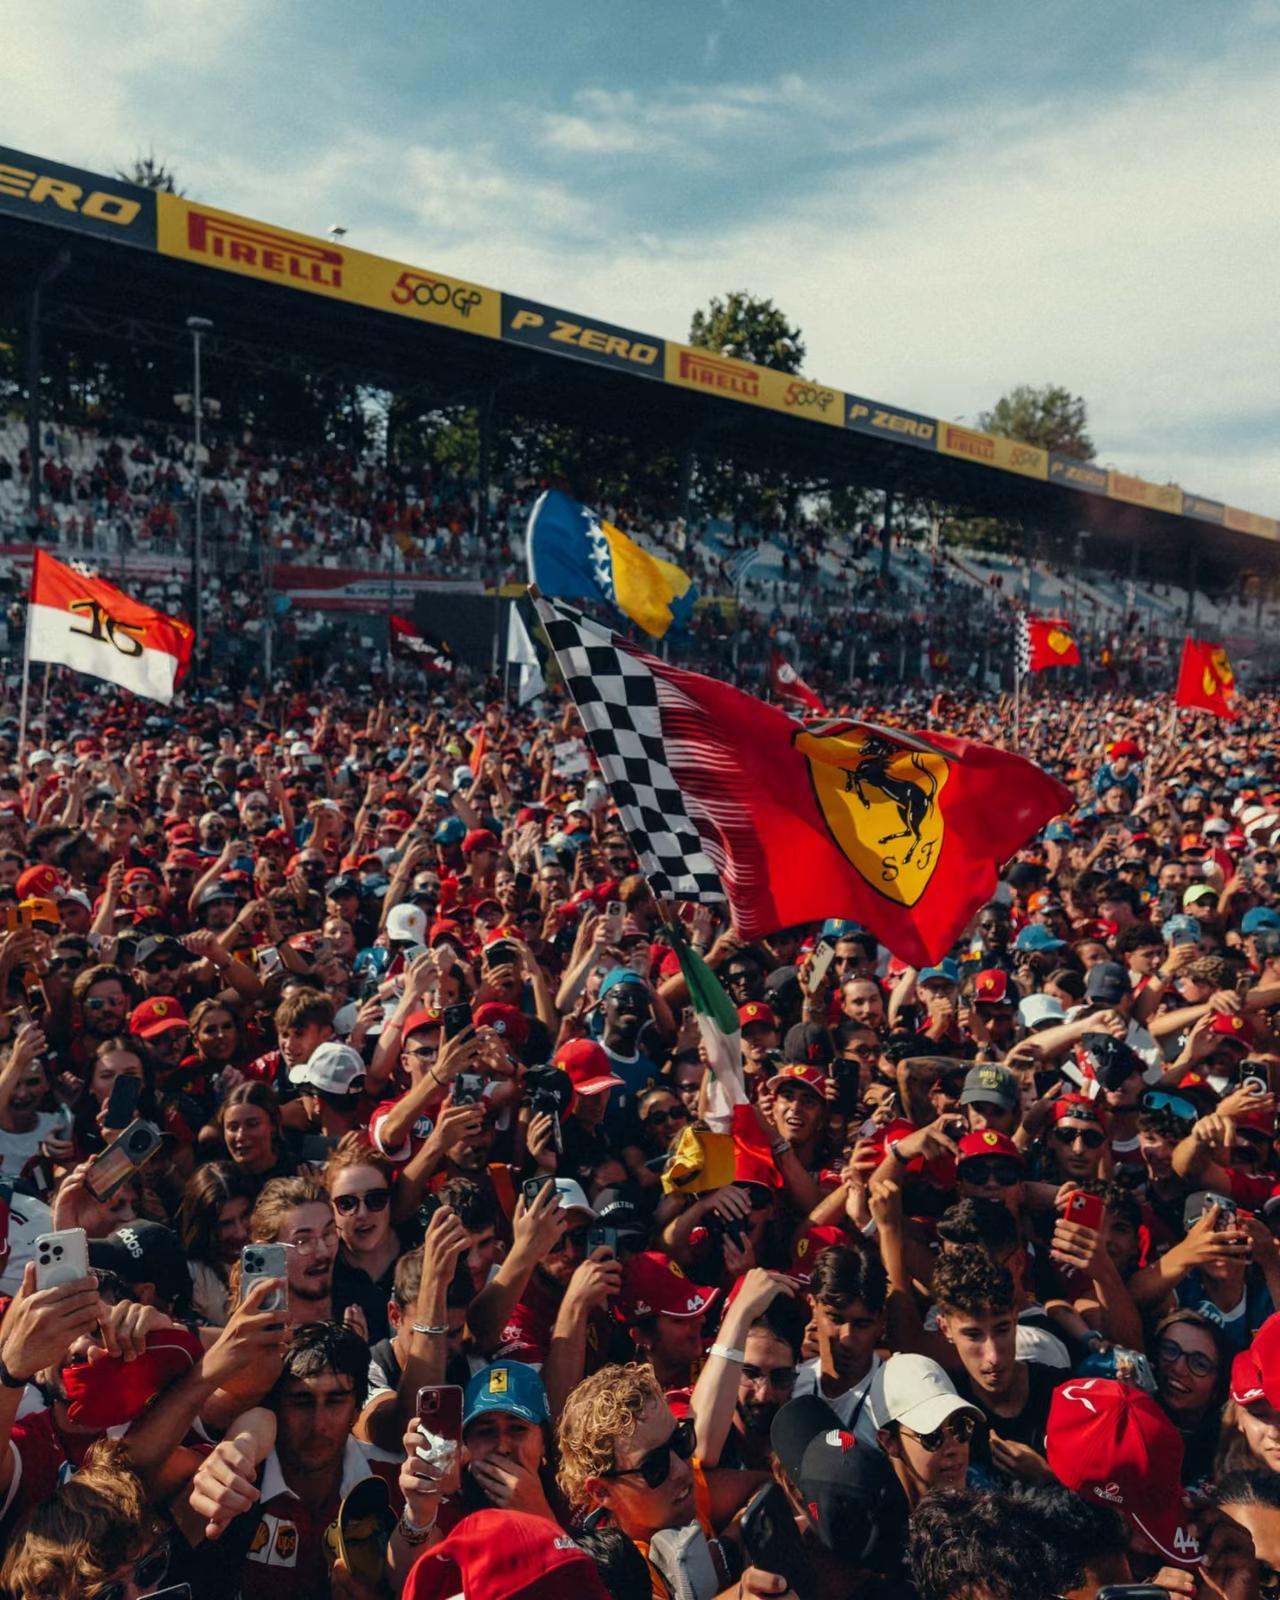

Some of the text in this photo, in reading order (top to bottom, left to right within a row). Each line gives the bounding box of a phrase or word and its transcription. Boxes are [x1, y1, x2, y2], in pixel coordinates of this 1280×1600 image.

[188, 210, 344, 287] PIRELLI
[510, 309, 659, 365] P ZERO
[680, 351, 759, 397] PIRELLI
[850, 403, 935, 439] P ZERO
[881, 856, 899, 882] S
[116, 1228, 144, 1258] didas
[686, 1294, 705, 1312] 44
[1173, 1526, 1200, 1554] 44
